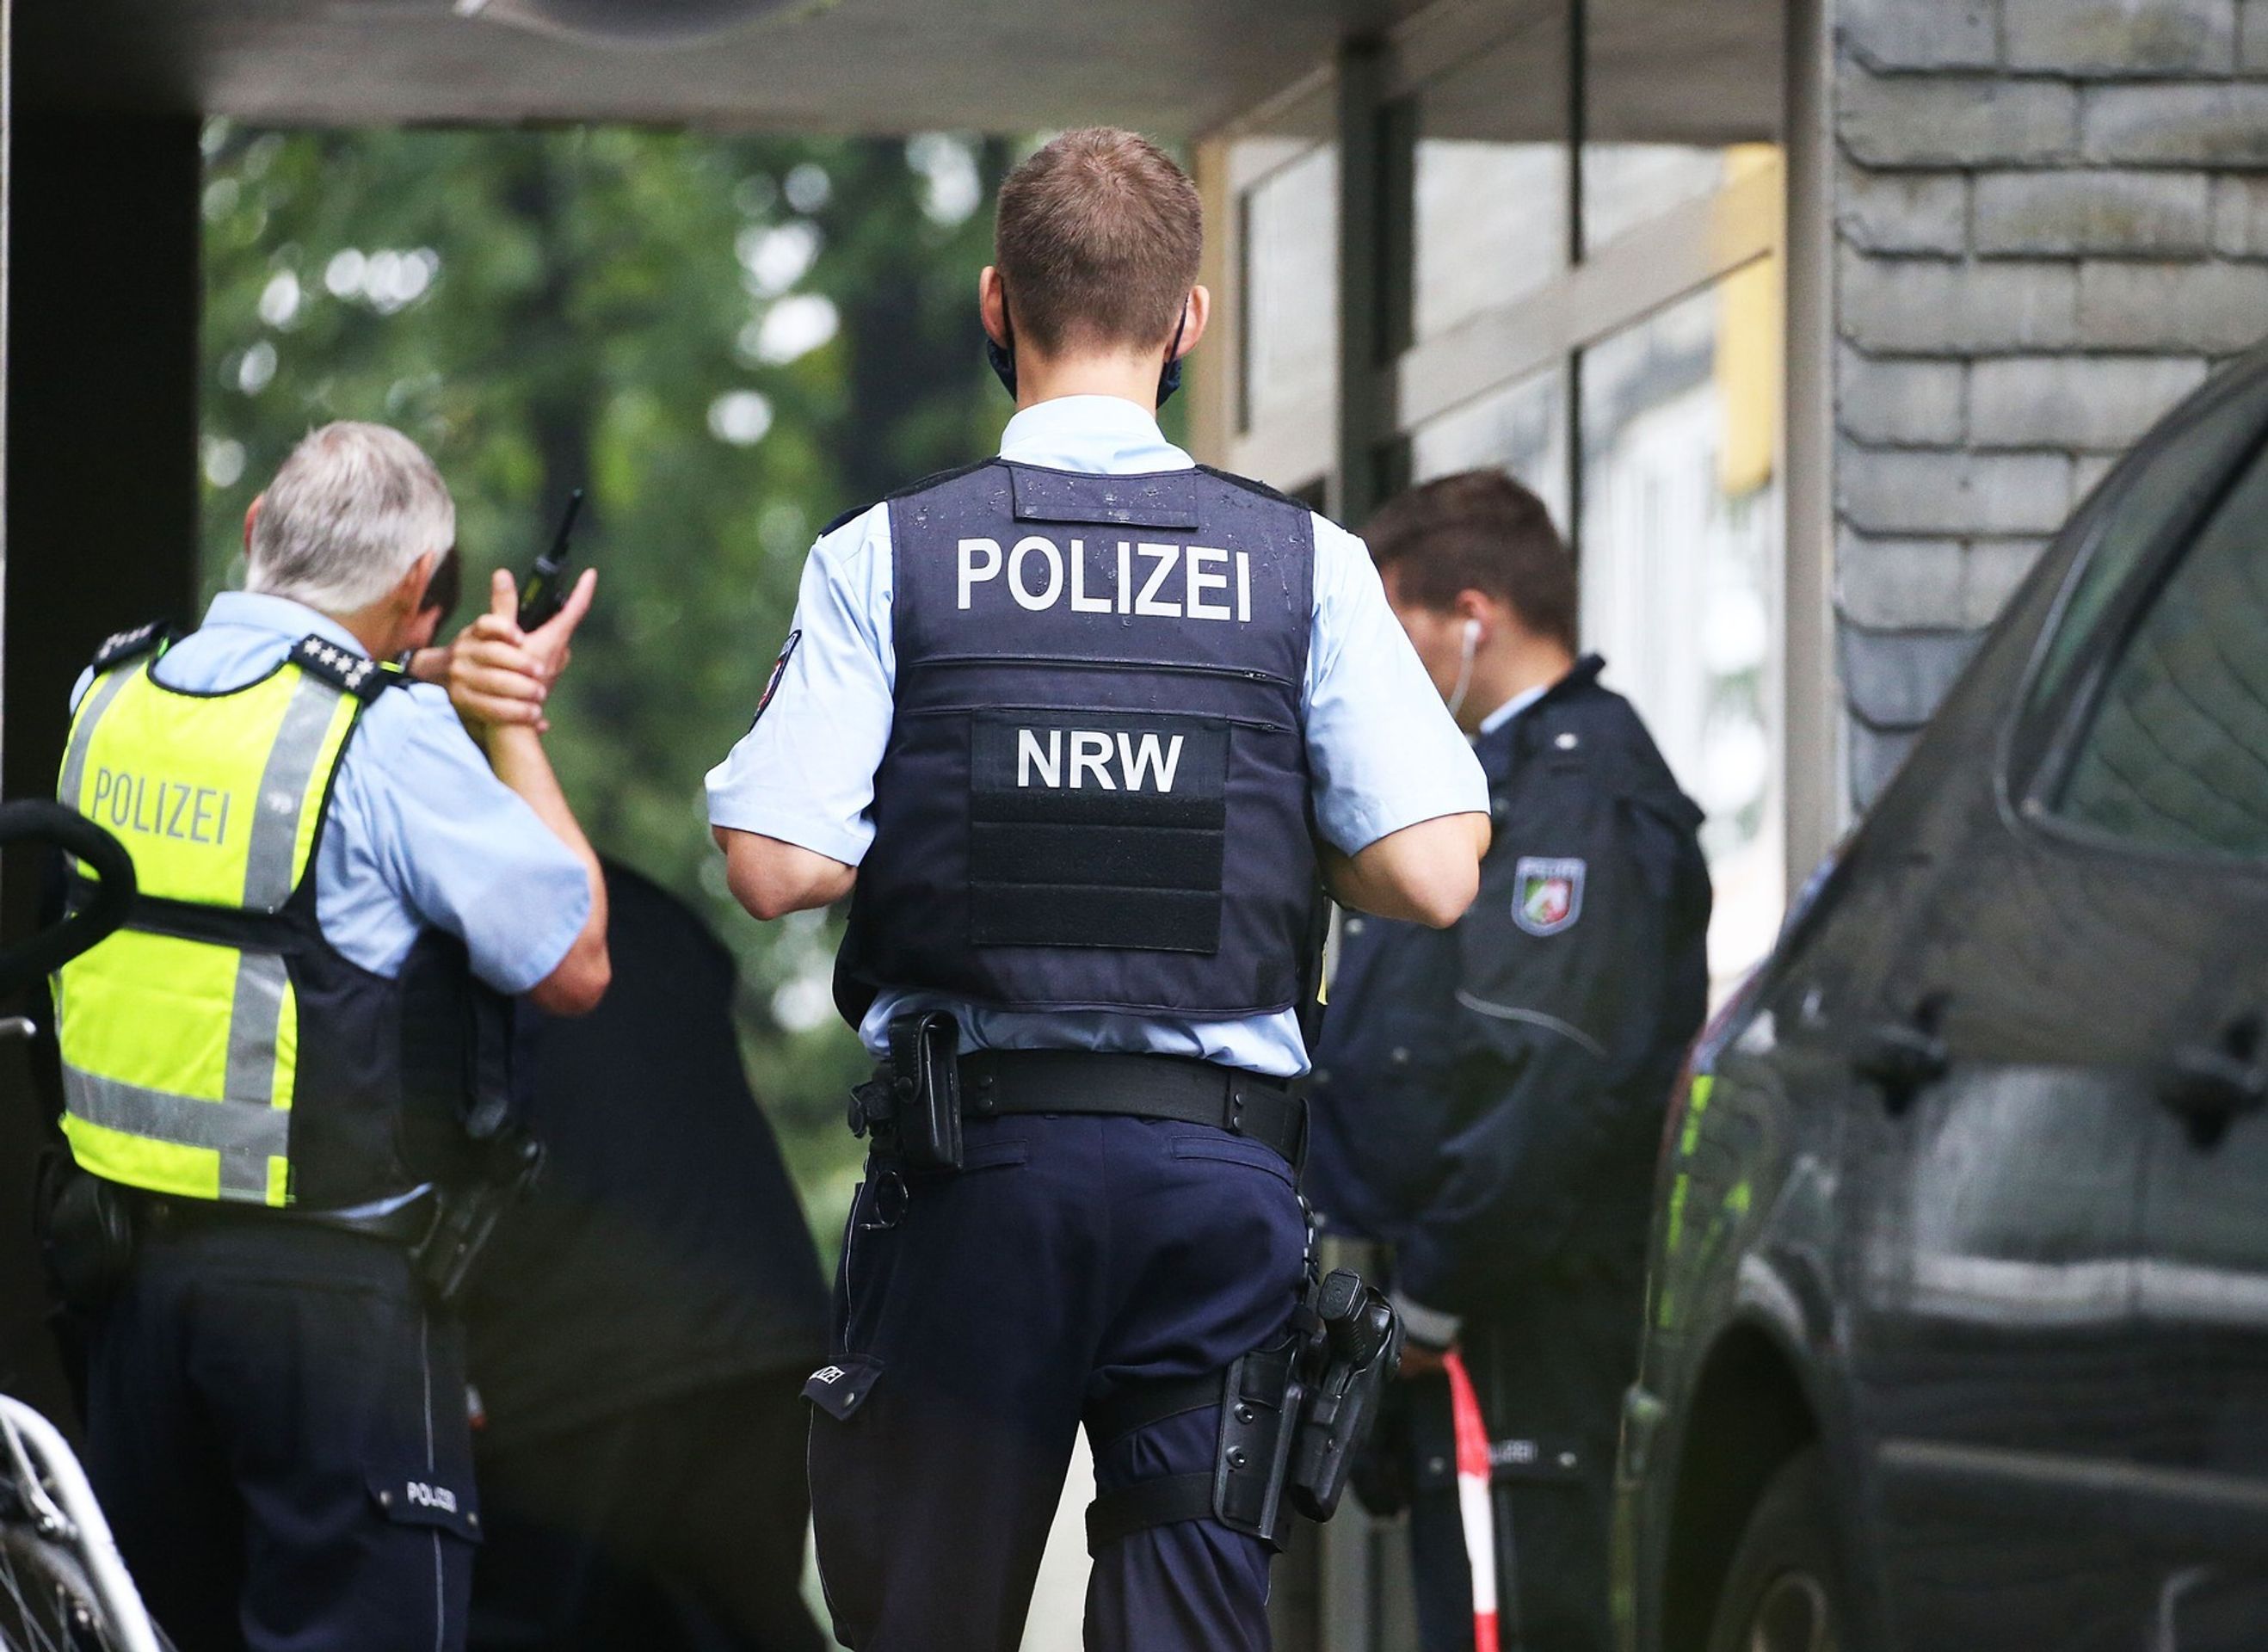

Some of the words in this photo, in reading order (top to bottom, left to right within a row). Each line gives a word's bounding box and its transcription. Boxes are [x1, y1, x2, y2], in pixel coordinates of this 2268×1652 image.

[958, 536, 1252, 623] POLIZEI
[1017, 729, 1185, 792] NRW
[91, 767, 231, 845] POLIZEI
